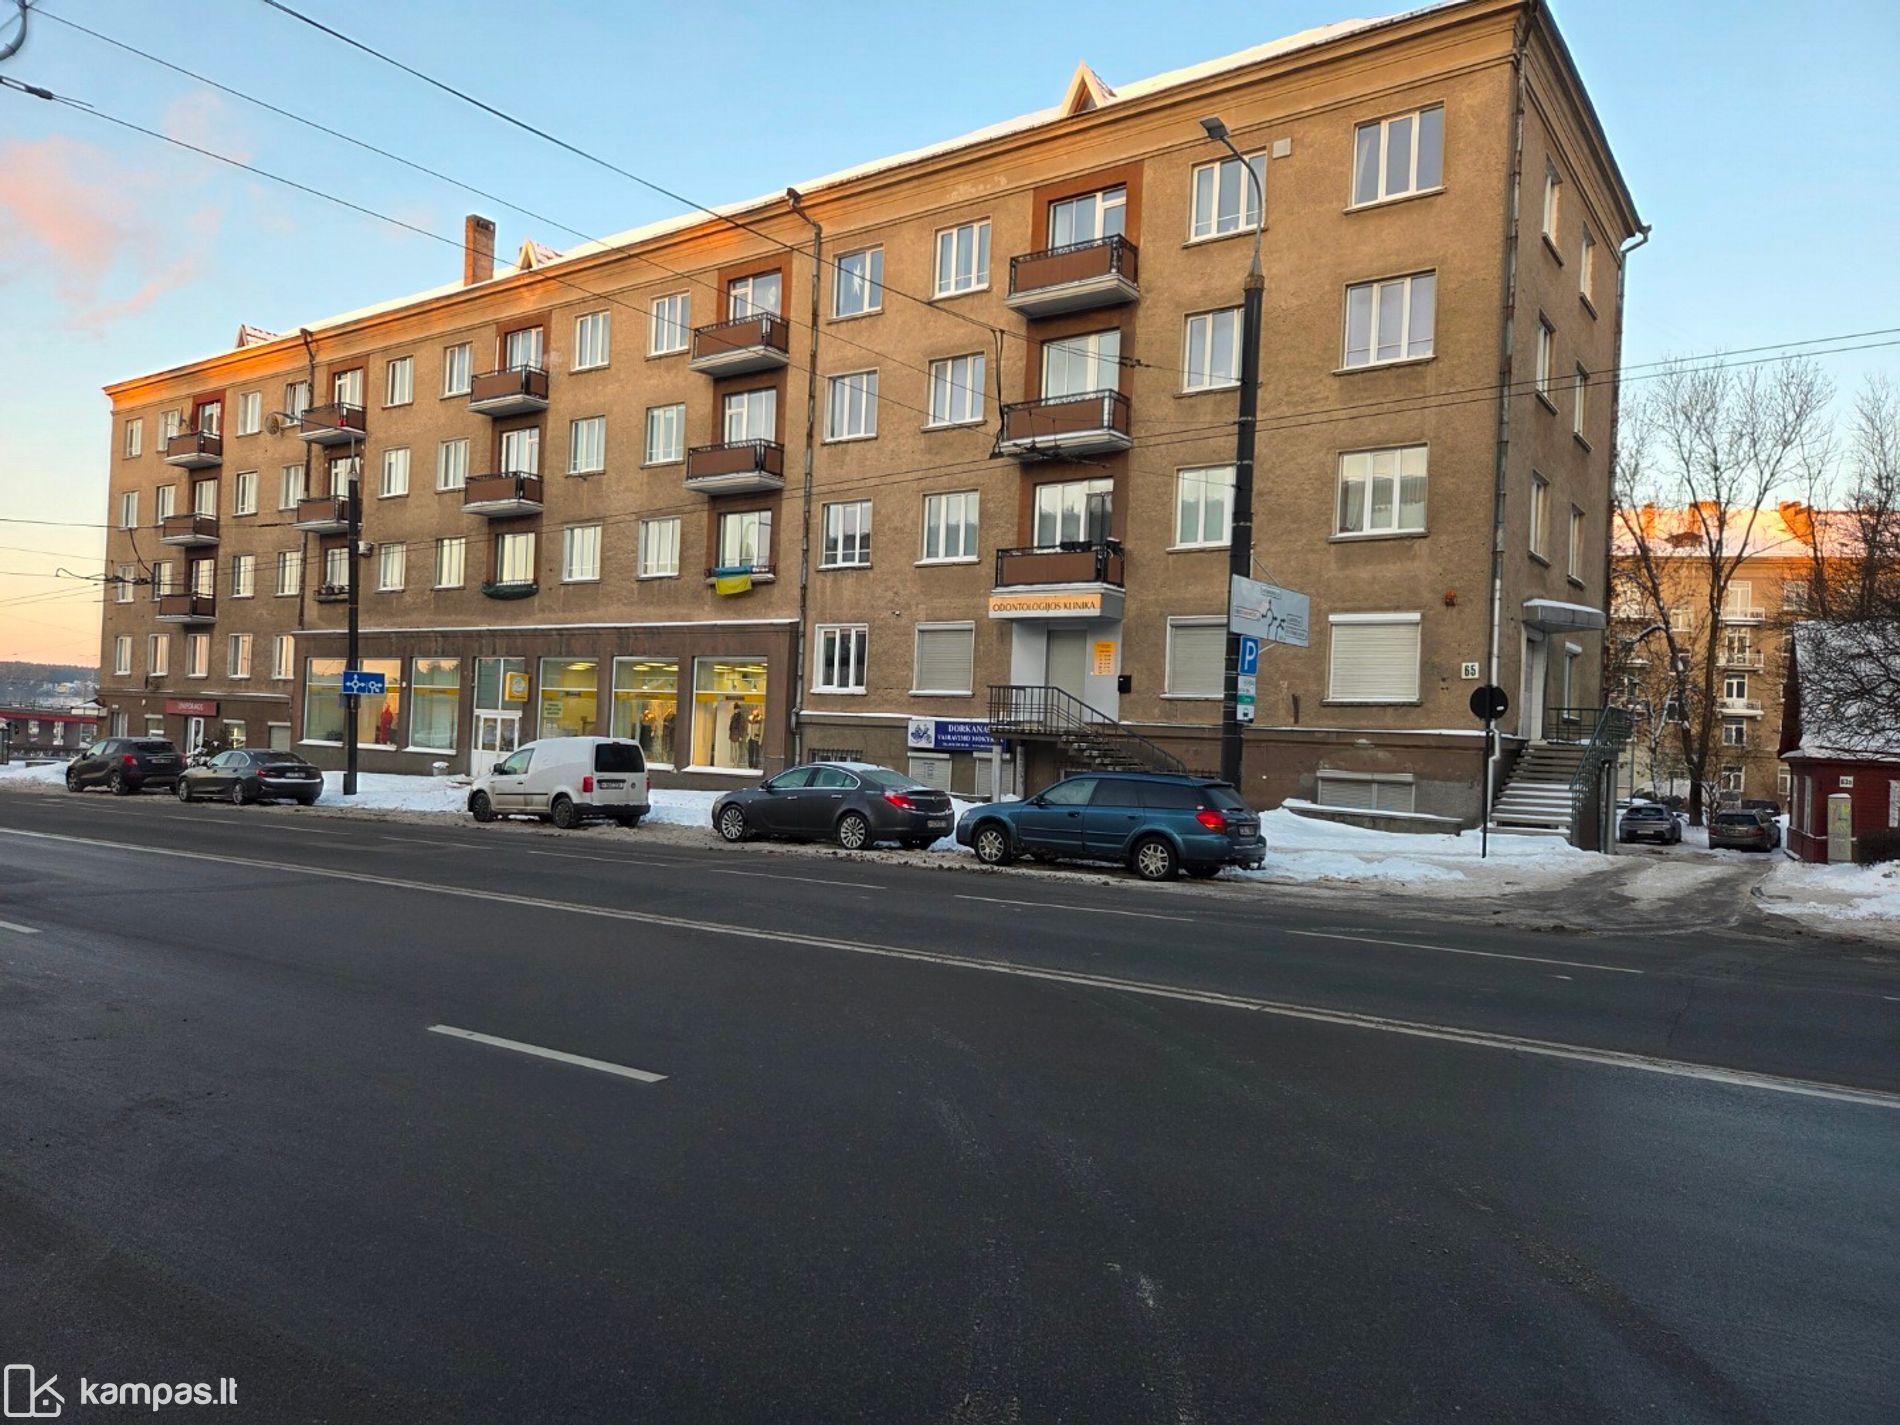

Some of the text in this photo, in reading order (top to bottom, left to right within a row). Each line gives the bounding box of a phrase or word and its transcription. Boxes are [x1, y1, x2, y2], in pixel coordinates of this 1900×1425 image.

[993, 601, 1096, 612] ODONTOLOGIJOS KLINIKA
[1244, 641, 1257, 671] P
[1464, 664, 1476, 677] 65
